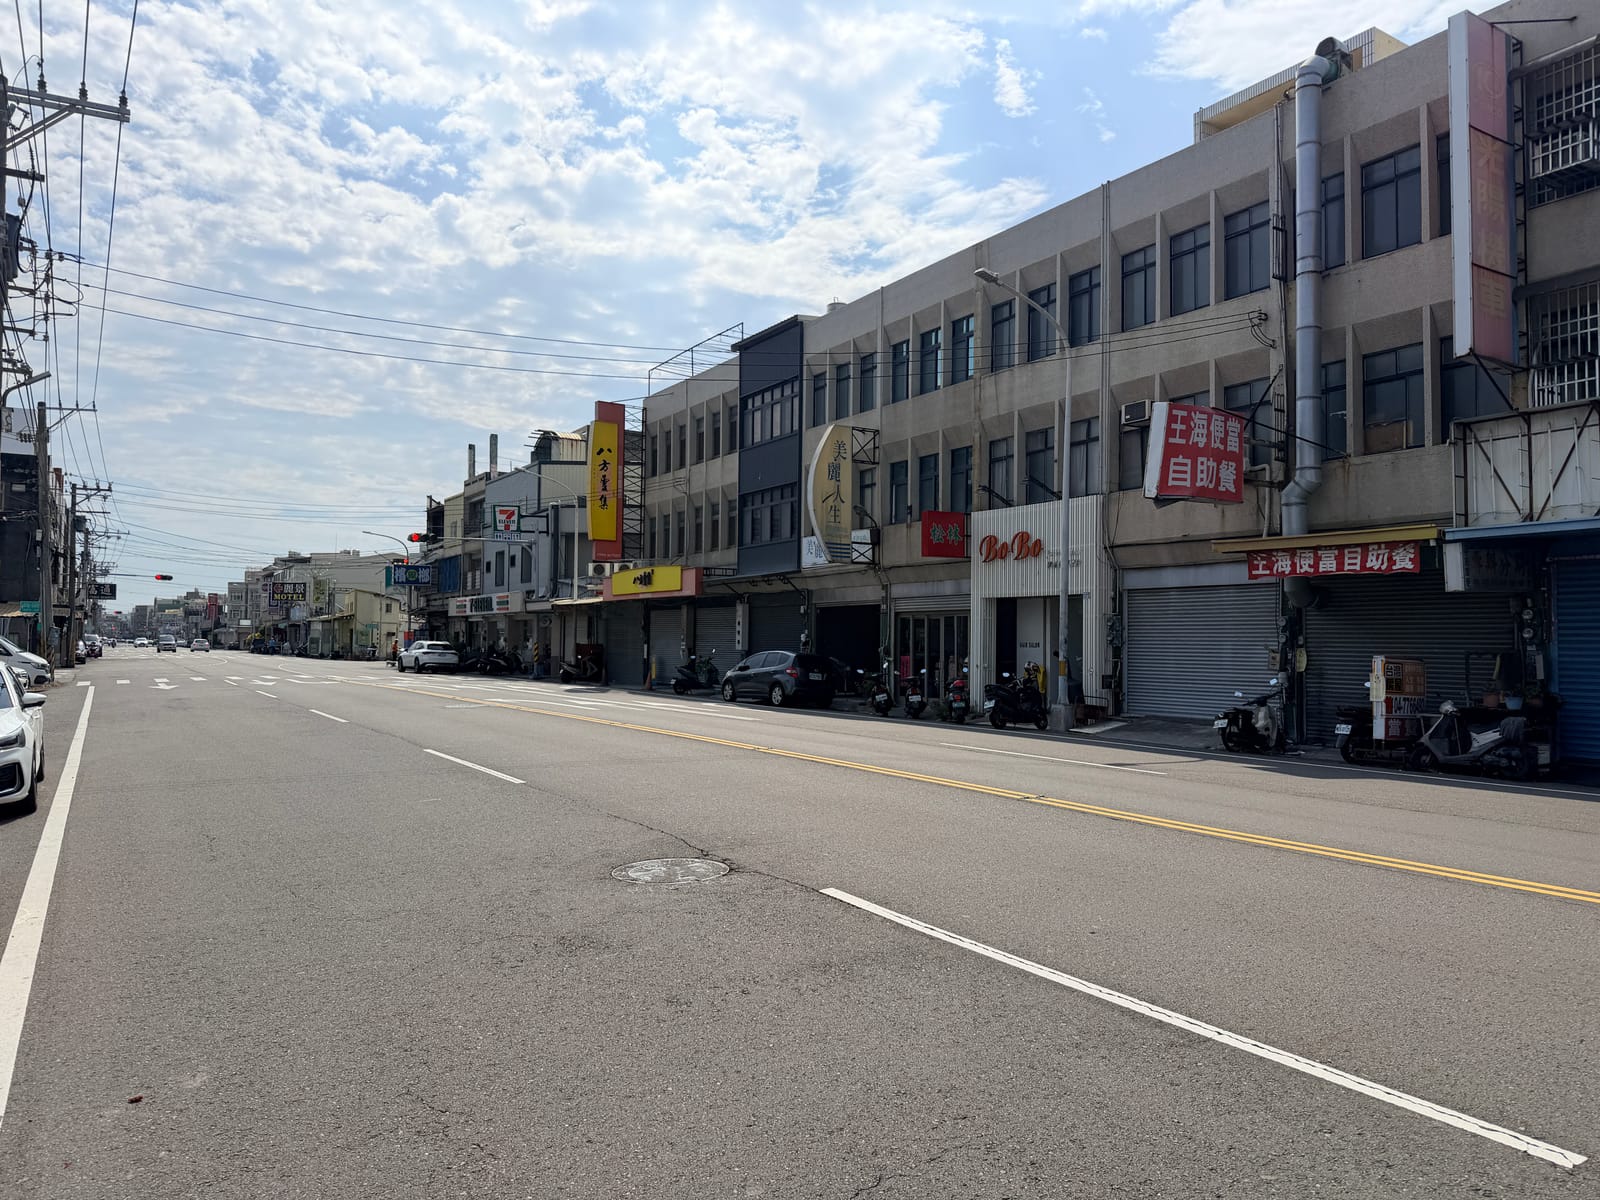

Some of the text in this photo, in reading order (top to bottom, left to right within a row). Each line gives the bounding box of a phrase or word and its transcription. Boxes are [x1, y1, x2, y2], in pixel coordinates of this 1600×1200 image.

[1168, 410, 1241, 453] 王海便當
[595, 447, 613, 510] 八方雲集
[822, 439, 848, 524] 美麗人生
[1167, 454, 1237, 493] 自助餐
[1251, 545, 1416, 575] 王海便當自助餐
[273, 593, 305, 601] MOTEL
